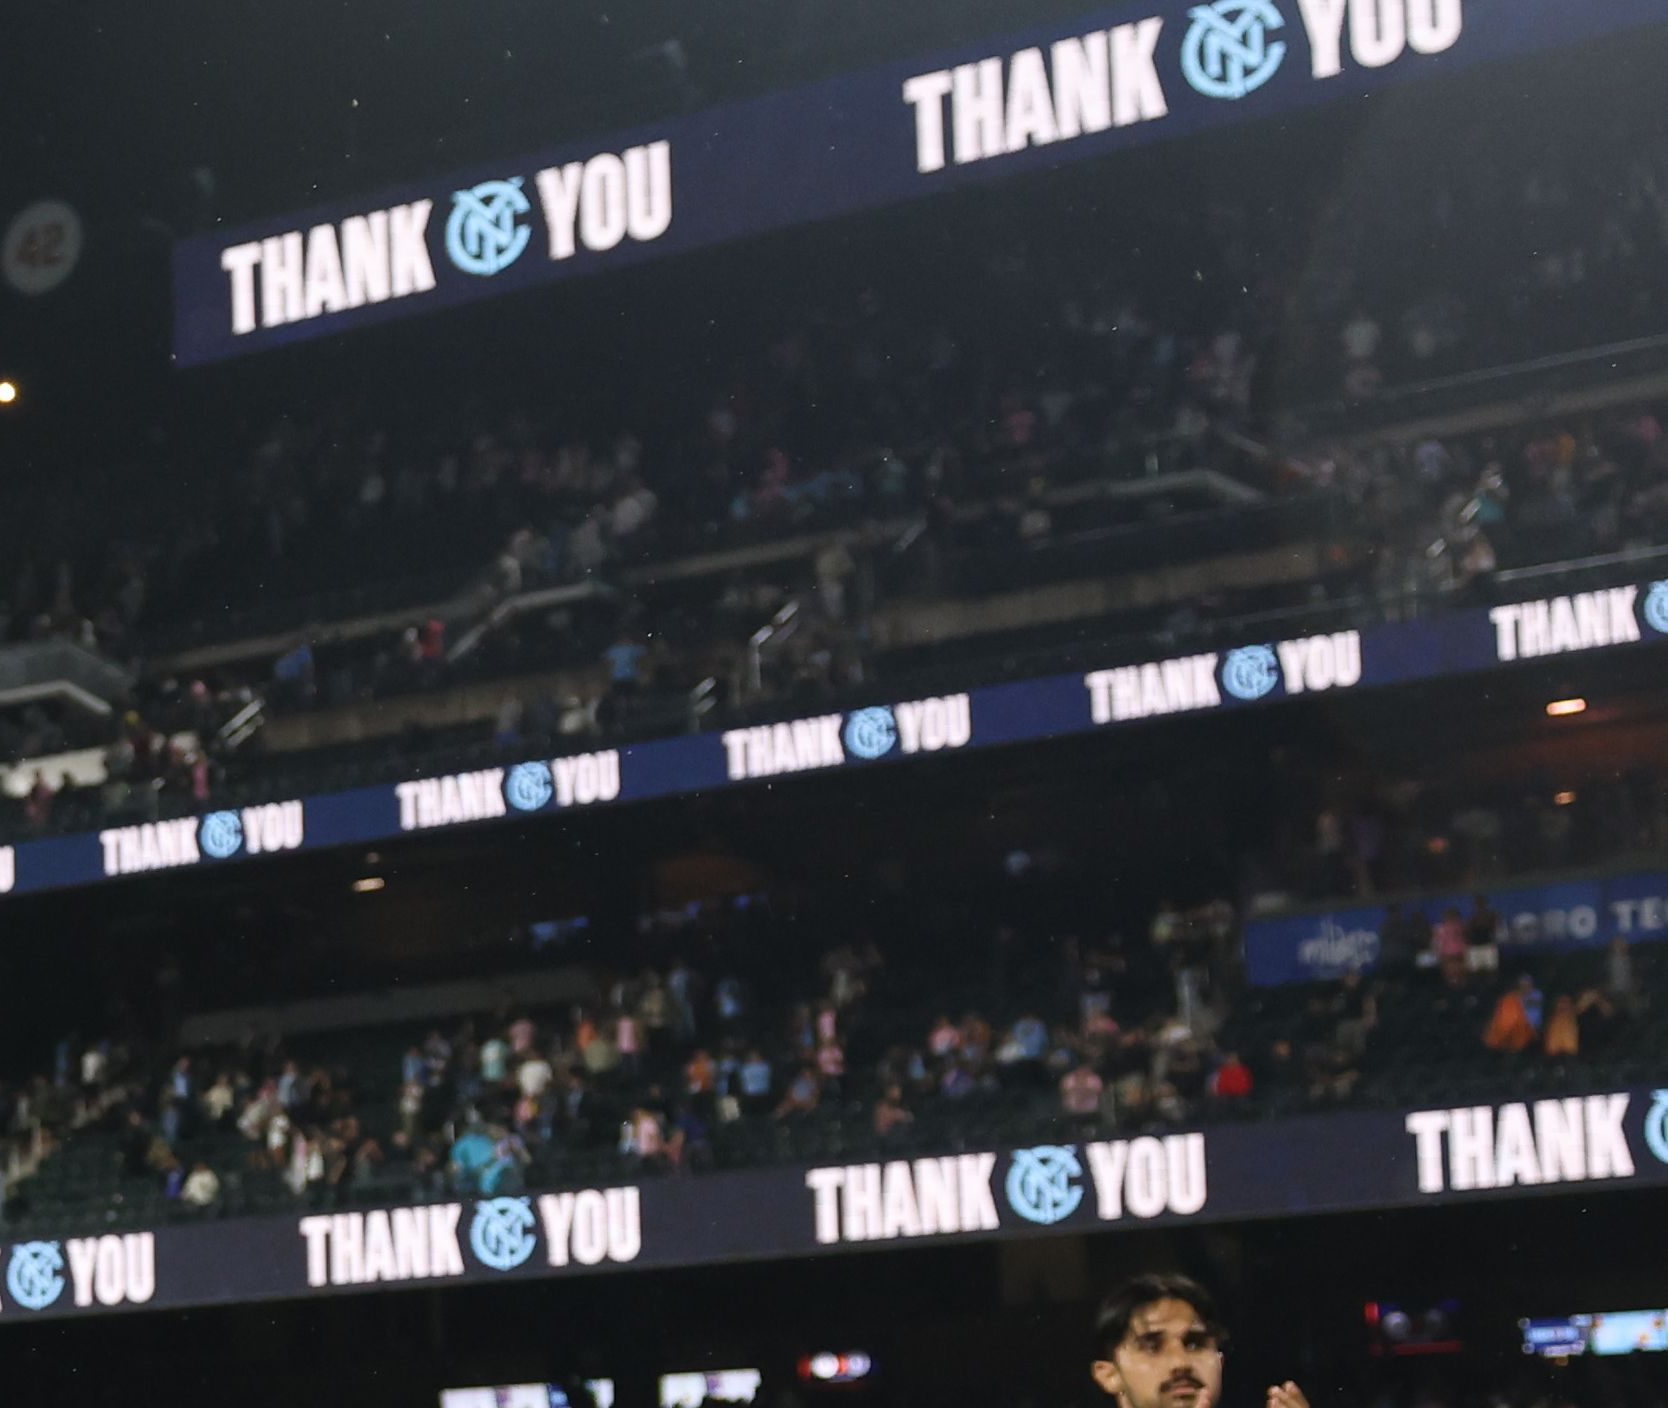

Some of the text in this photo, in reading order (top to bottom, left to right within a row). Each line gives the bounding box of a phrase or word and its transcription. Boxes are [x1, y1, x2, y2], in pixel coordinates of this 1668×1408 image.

[903, 17, 1167, 172] THANK
[222, 200, 435, 333] THANK
[537, 141, 671, 259] YOU
[1490, 586, 1640, 660] THANK
[1086, 631, 1361, 723] THANK YOU
[723, 694, 970, 779] THANK YOU
[396, 750, 619, 830] THANK YOU
[100, 801, 303, 875] THANK YOU
[807, 1153, 999, 1243] THANK
[1087, 1133, 1206, 1219] YOU
[1407, 1093, 1634, 1192] THANK
[67, 1232, 154, 1306] YOU
[300, 1203, 464, 1286] THANK
[539, 1187, 640, 1266] YOU
